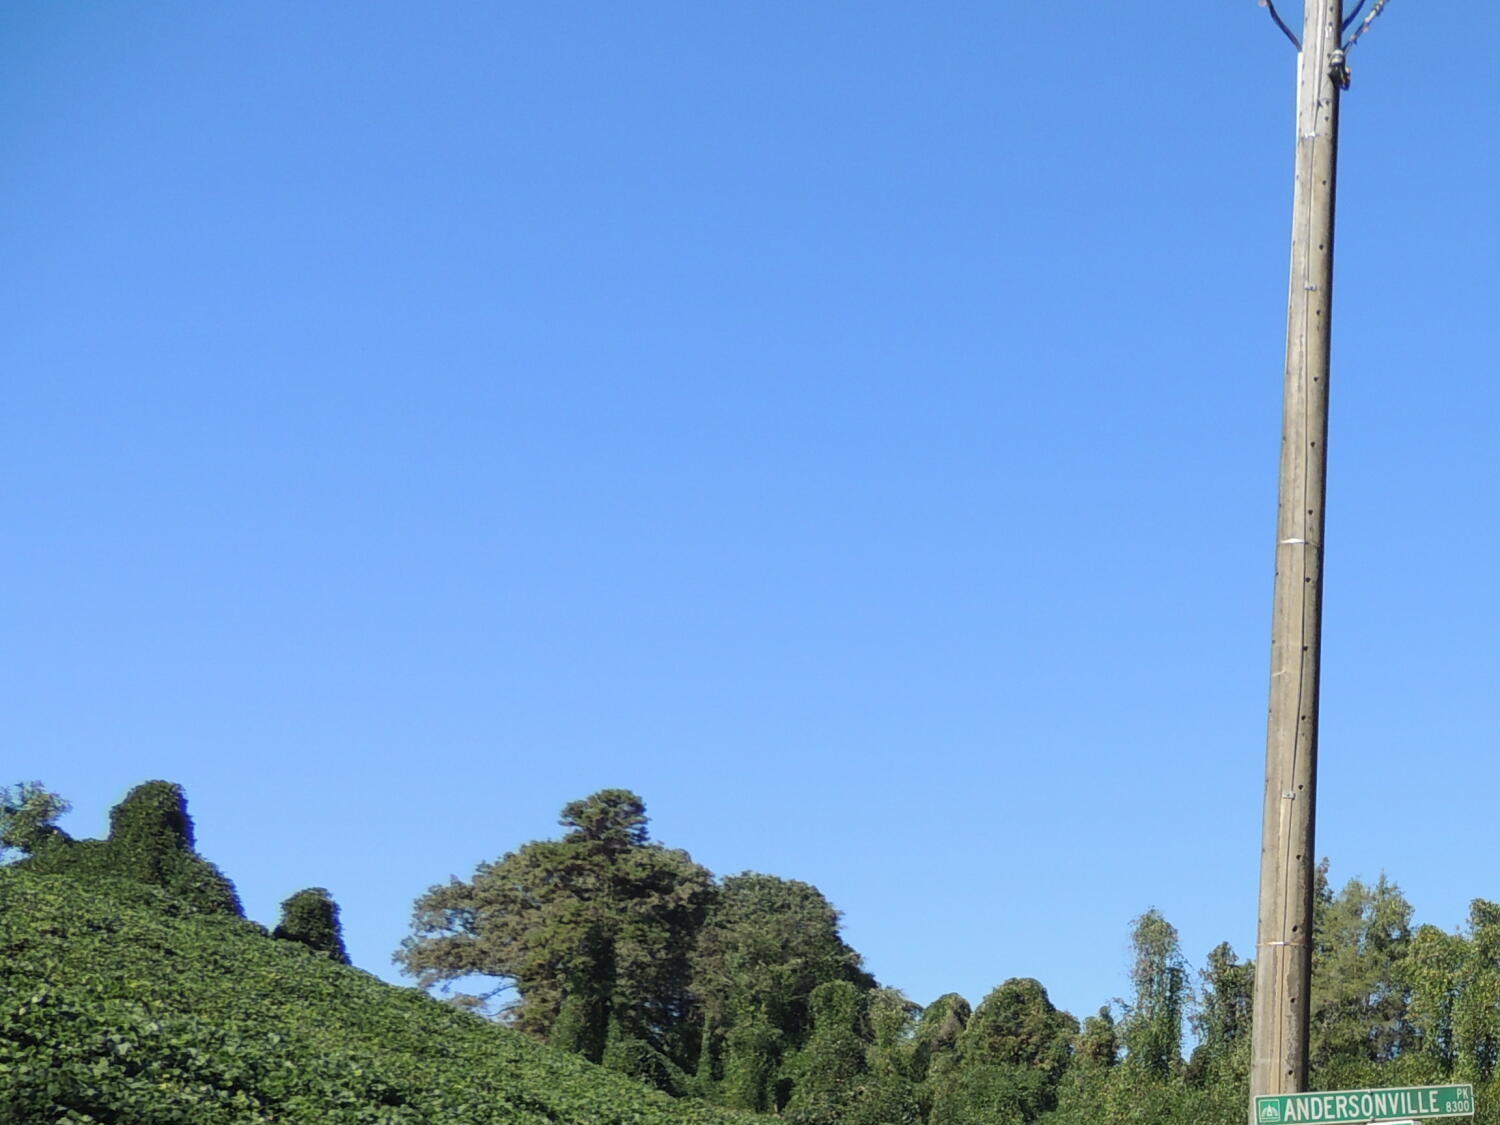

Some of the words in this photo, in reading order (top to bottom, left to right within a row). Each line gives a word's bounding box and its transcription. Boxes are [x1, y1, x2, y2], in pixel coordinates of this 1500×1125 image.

[1456, 1089, 1469, 1100] PK
[1284, 1090, 1440, 1122] ANDERSONVILLE
[1446, 1100, 1470, 1113] 8300
